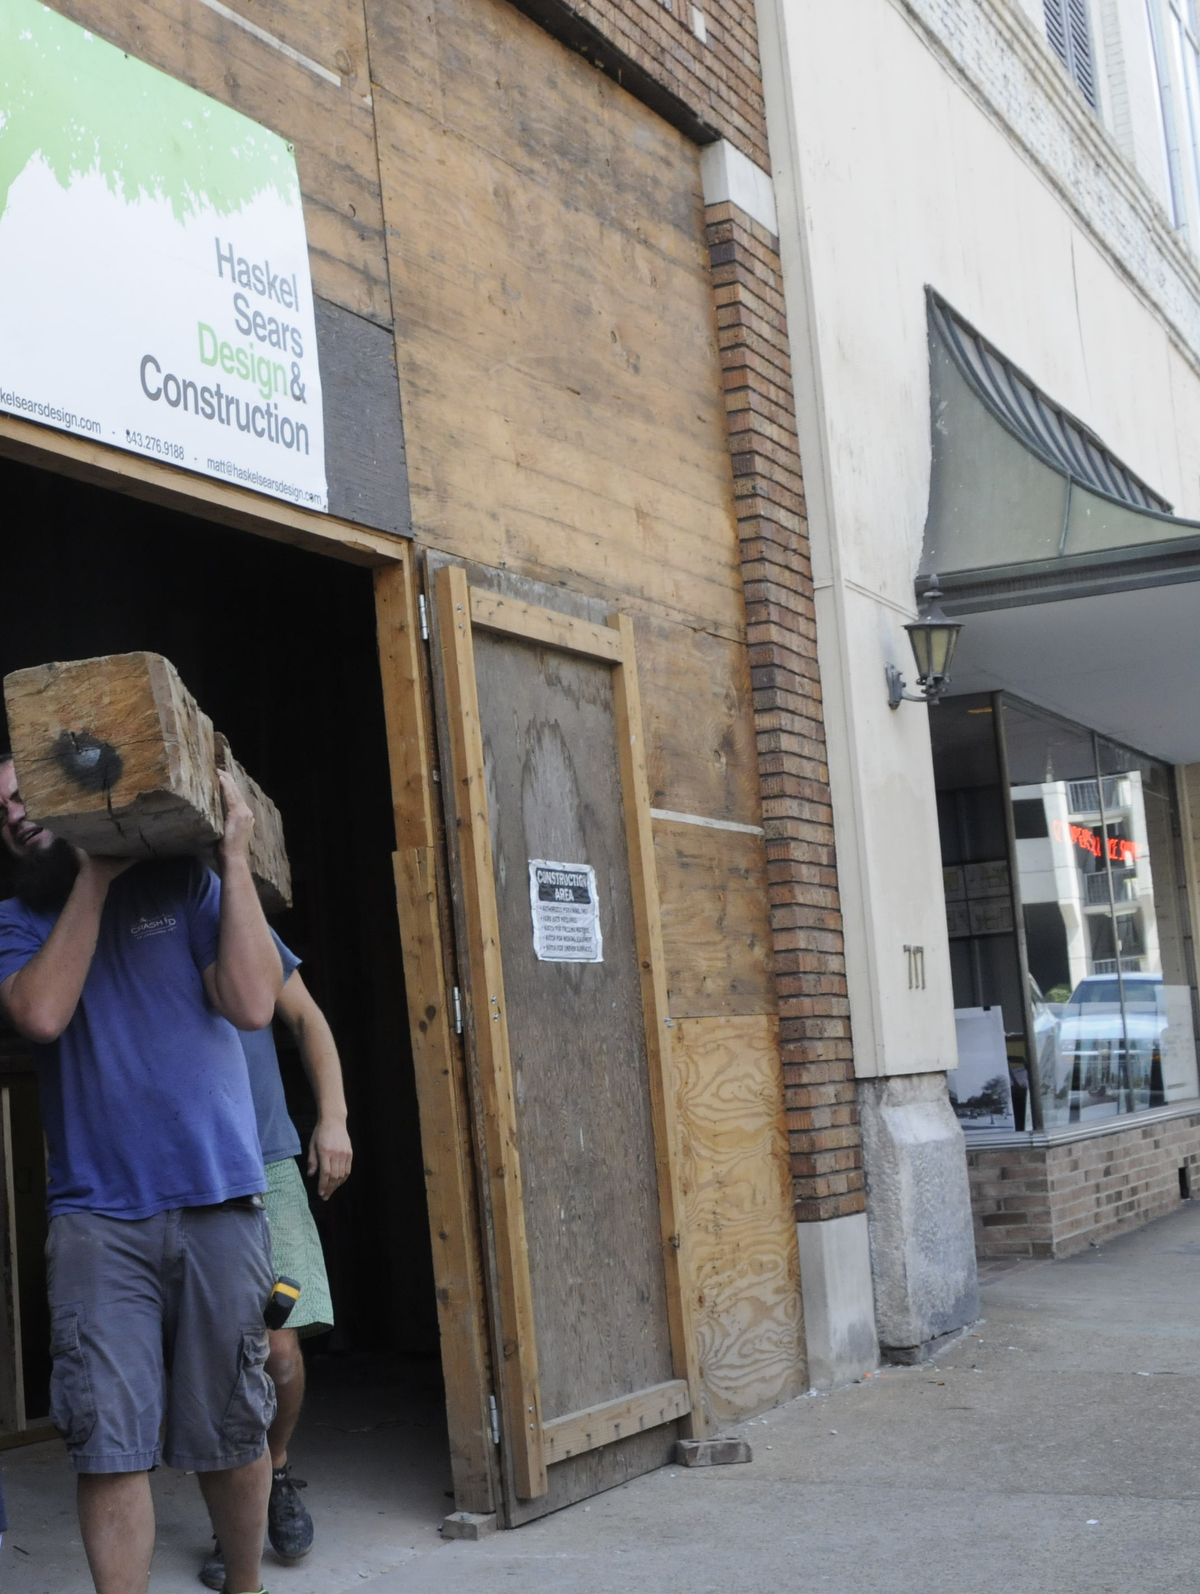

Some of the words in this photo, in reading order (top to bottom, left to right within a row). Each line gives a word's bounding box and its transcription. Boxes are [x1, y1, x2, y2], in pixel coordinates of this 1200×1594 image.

[215, 237, 299, 312] Haskel
[233, 292, 303, 358] Sears
[140, 354, 309, 455] Construction
[537, 871, 588, 887] CONSTRUCTION
[555, 888, 575, 902] AREA
